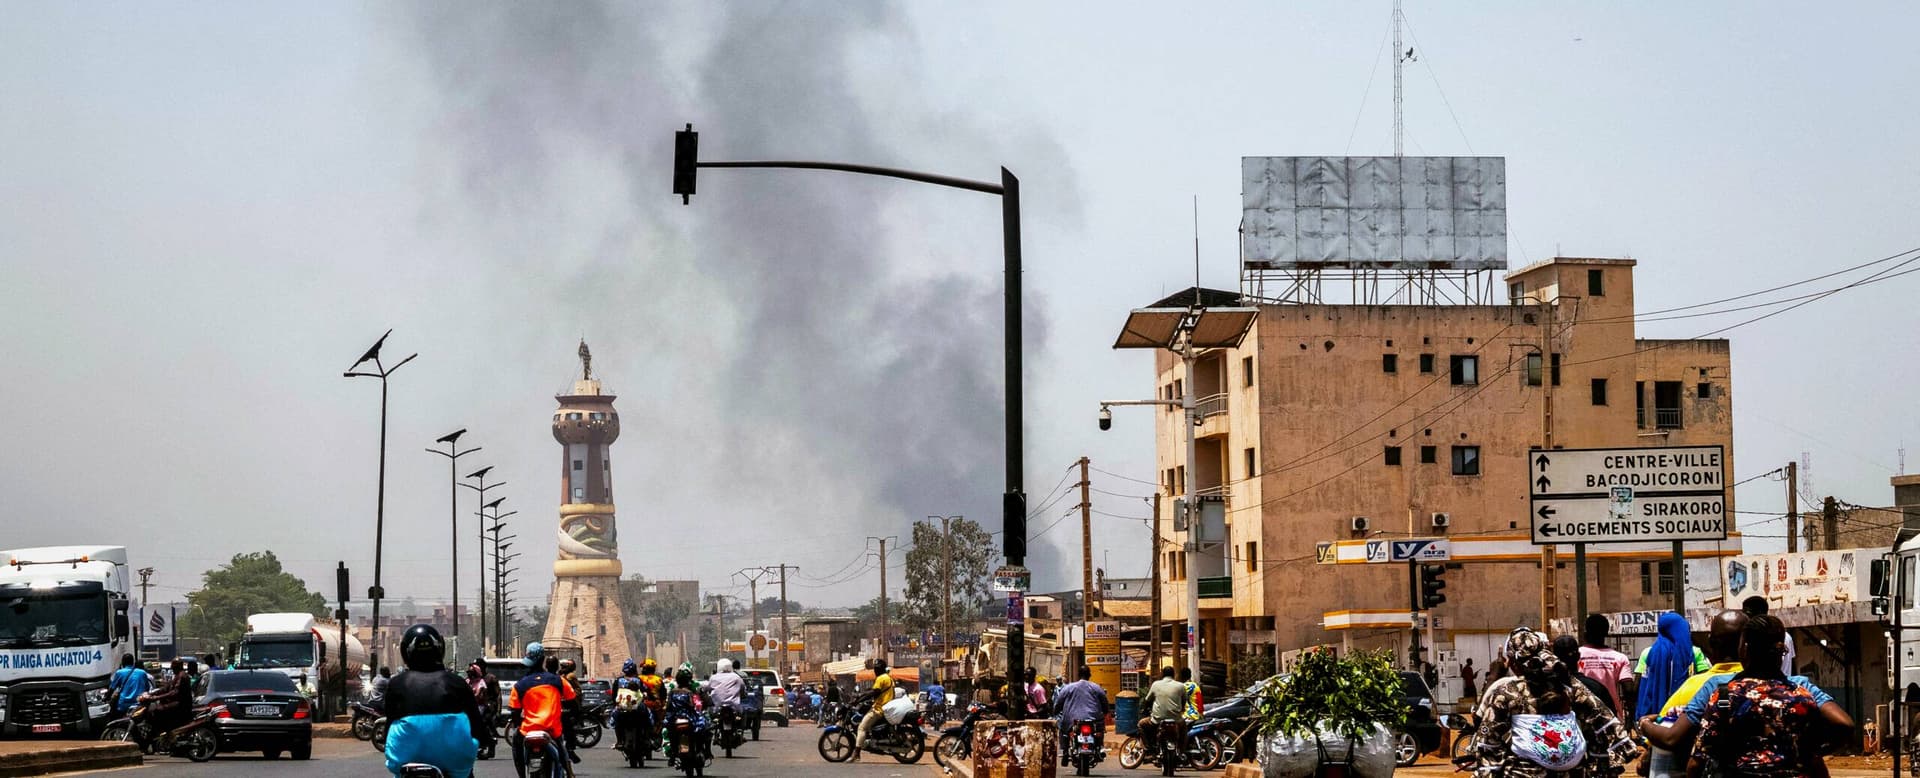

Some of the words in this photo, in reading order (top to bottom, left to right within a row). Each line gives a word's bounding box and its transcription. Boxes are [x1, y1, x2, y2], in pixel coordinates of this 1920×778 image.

[1604, 454, 1720, 469] CENTRE-VILLE
[1586, 472, 1720, 487] BACODJICORONI
[1643, 501, 1722, 516] SIRAKORO
[1557, 521, 1651, 536] LOGEMENTS
[1655, 519, 1722, 534] SOCIAUX
[1620, 611, 1659, 625] DEN
[1643, 625, 1658, 633] PAR
[13, 654, 43, 668] MAIGA
[45, 651, 92, 668] AICHATOU
[93, 650, 103, 661] 4
